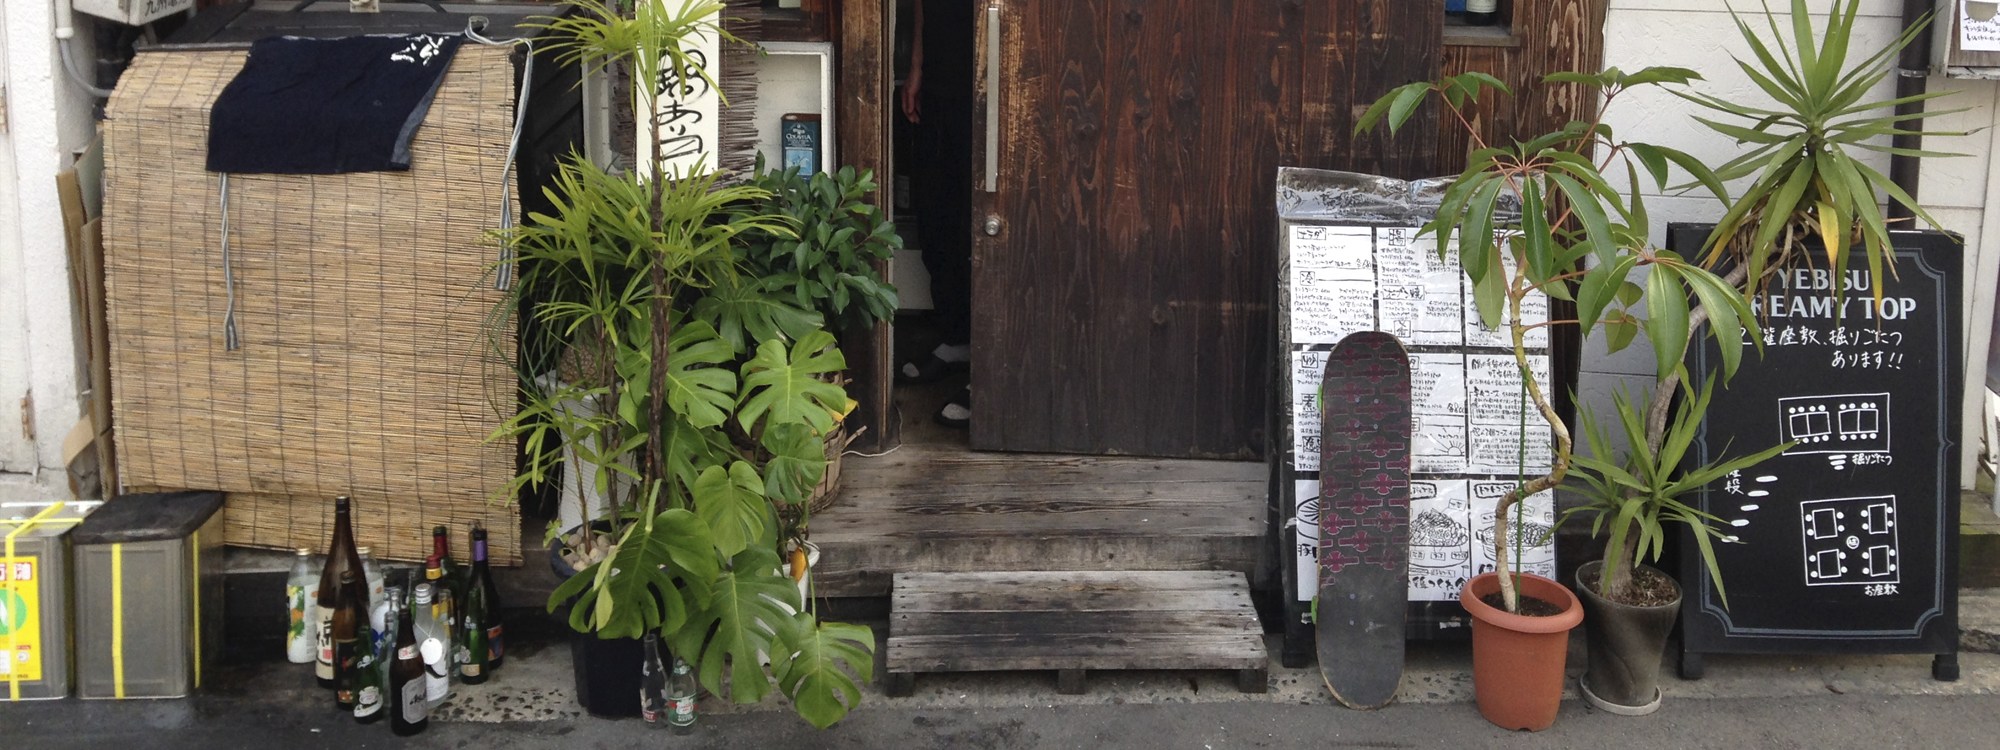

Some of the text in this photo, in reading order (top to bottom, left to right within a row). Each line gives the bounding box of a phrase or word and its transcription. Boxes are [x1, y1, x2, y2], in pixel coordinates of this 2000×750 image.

[1777, 268, 1870, 291] YEBISU
[1743, 295, 1917, 320] REAMY TOP
